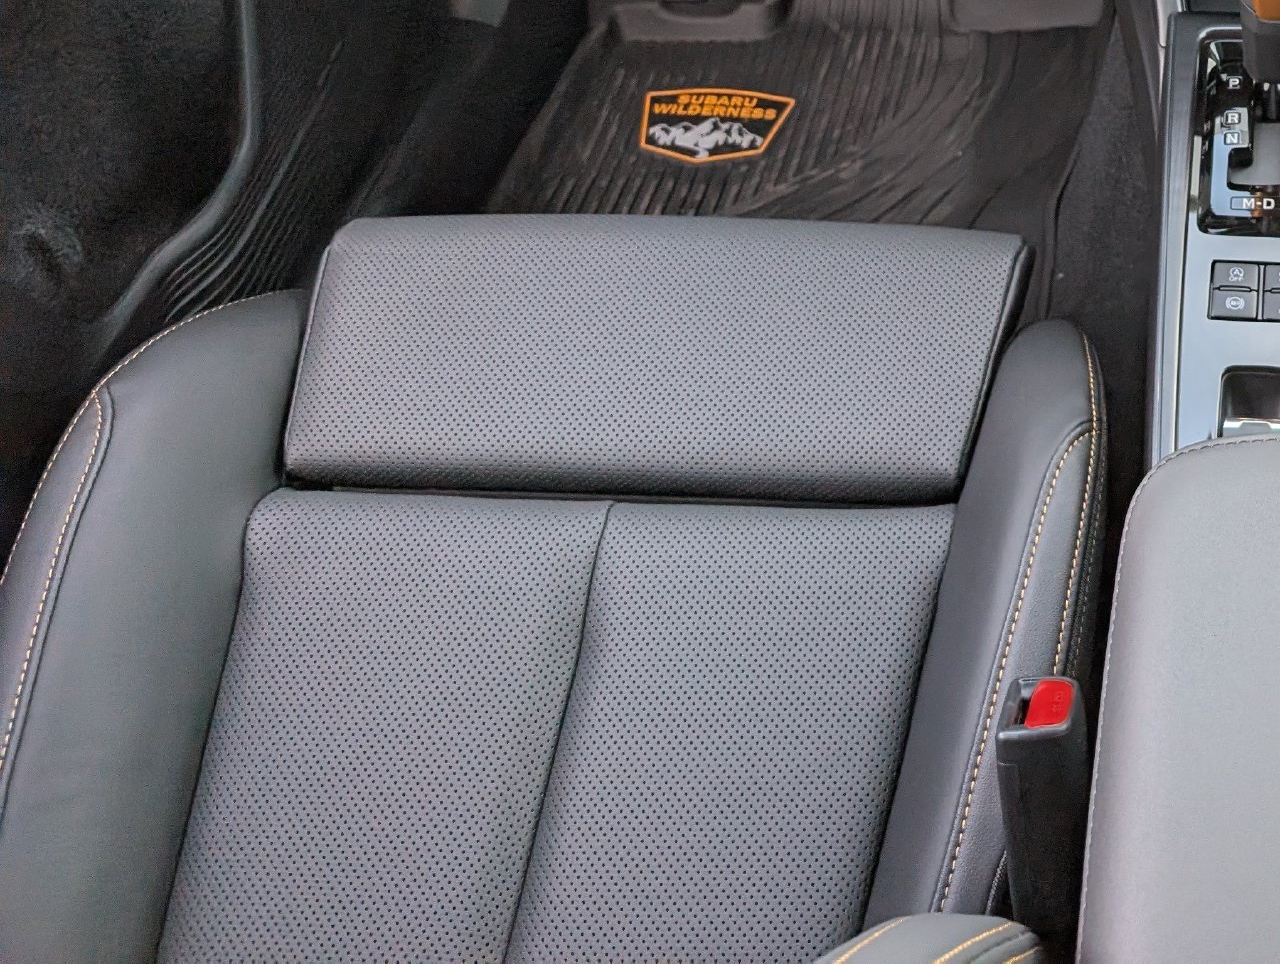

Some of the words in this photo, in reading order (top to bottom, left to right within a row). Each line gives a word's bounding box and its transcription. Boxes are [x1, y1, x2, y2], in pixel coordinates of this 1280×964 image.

[1229, 77, 1240, 87] P
[677, 93, 758, 108] SUBARU
[653, 102, 777, 121] WILDERNESS
[1227, 113, 1239, 123] R
[1226, 133, 1238, 144] N
